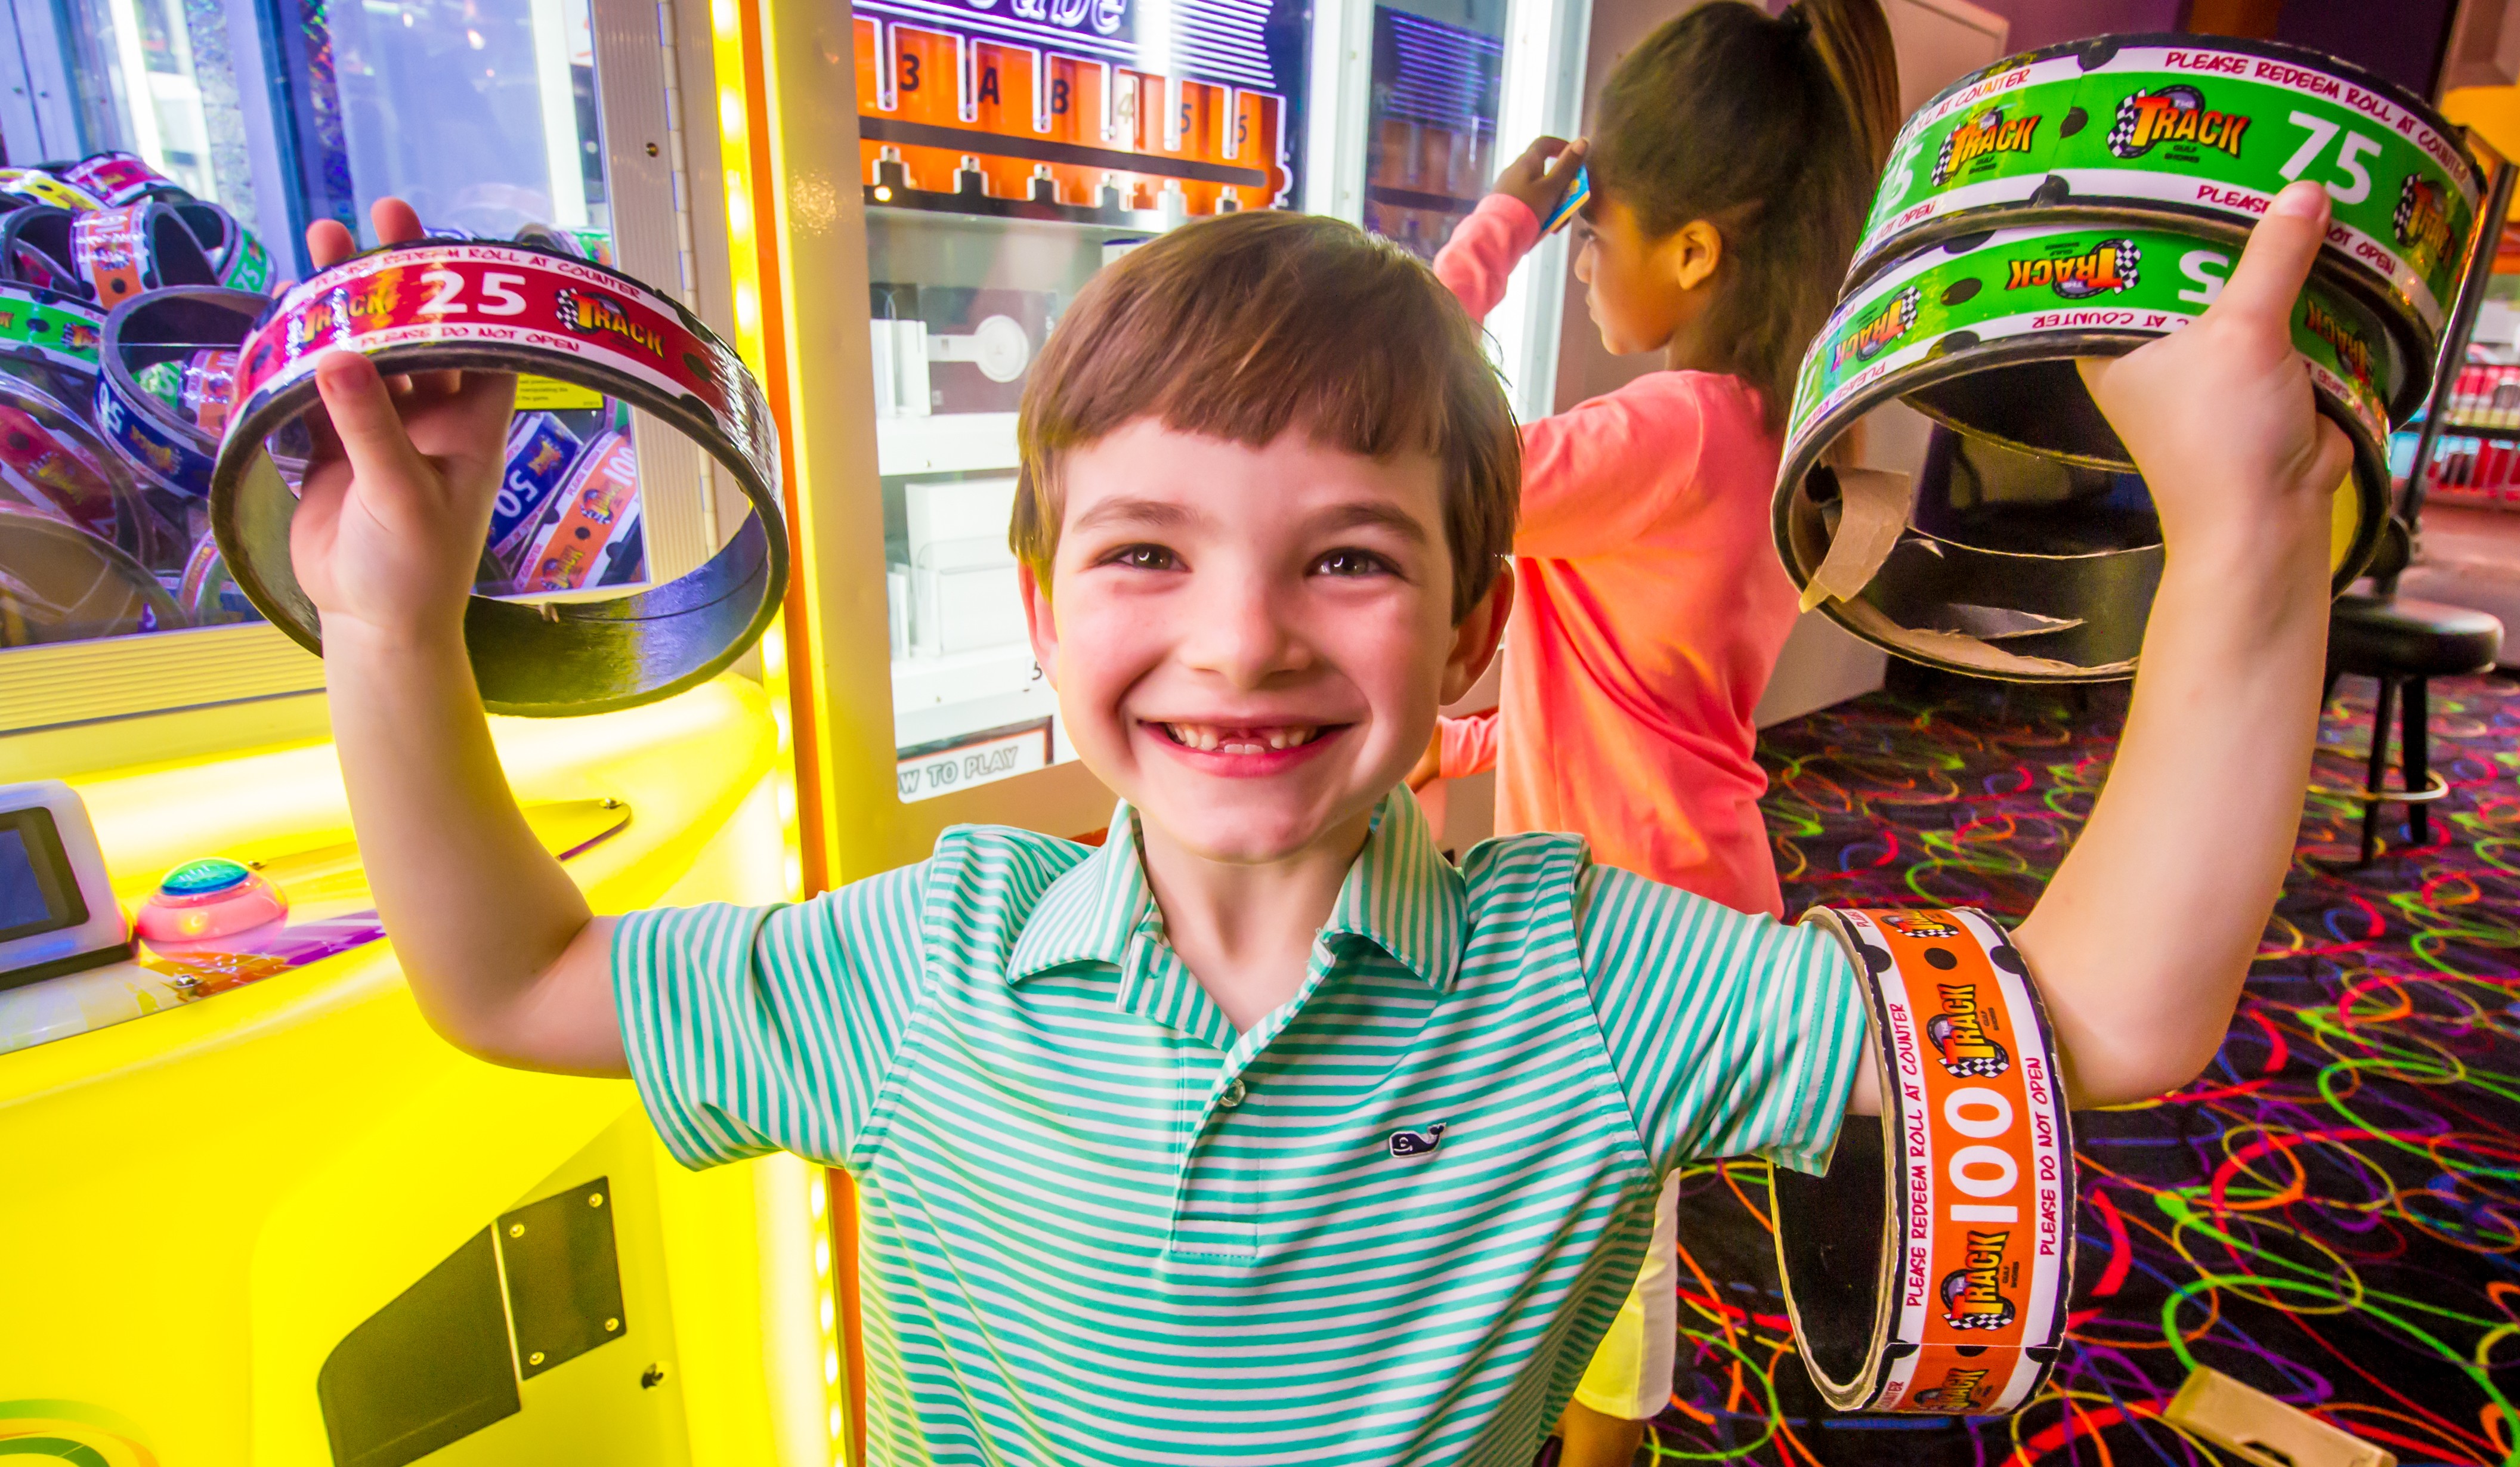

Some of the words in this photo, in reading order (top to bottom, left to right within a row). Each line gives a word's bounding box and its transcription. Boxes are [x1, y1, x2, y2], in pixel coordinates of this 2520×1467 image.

[899, 54, 920, 92] 3
[978, 67, 1000, 106] A
[1051, 79, 1069, 114] B
[1179, 103, 1192, 134] 5
[1936, 98, 1953, 118] AT
[1955, 69, 2030, 107] COUNTER
[2165, 51, 2249, 76] PLEASE
[2254, 62, 2340, 99] REDEEM
[2345, 88, 2391, 123] ROLL
[2397, 116, 2416, 135] AT
[1946, 114, 2042, 173] TRACK
[2131, 96, 2251, 159] TRACK
[2278, 111, 2383, 205] 75
[1898, 200, 1937, 228] OPEN
[468, 248, 520, 262] ROLL
[529, 256, 550, 268] AT
[557, 262, 641, 299] COUNTER
[2005, 247, 2123, 290] TRACK
[2178, 250, 2230, 305] 5
[2357, 243, 2397, 276] OPEN
[417, 270, 527, 316] 25
[361, 327, 431, 348] PLEASE
[441, 326, 469, 337] DO
[478, 328, 518, 340] NOT
[525, 333, 580, 353] OPEN
[570, 291, 666, 360] TRACK
[1831, 299, 1905, 373] TRACK
[2032, 312, 2134, 329] COUNTER
[2142, 315, 2167, 327] AT
[1833, 361, 1886, 403] PLEASE
[494, 469, 538, 518] 50
[898, 769, 920, 794] W
[927, 761, 958, 788] TO
[964, 746, 1019, 780] PLAY
[1890, 1004, 1917, 1076] COUNTER
[1937, 983, 1996, 1064] TRACK
[1903, 1084, 1922, 1102] AT
[2025, 1057, 2048, 1105] OPEN
[1909, 1109, 1928, 1158] ROLL
[1944, 1087, 2020, 1222] 100
[2038, 1112, 2054, 1148] NOT
[2040, 1155, 2056, 1181] DO
[1911, 1162, 1928, 1239] REDEEM
[2040, 1189, 2057, 1256] PLEASE
[1906, 1247, 1927, 1307] PLEASE
[1950, 1230, 2011, 1319] TRACK
